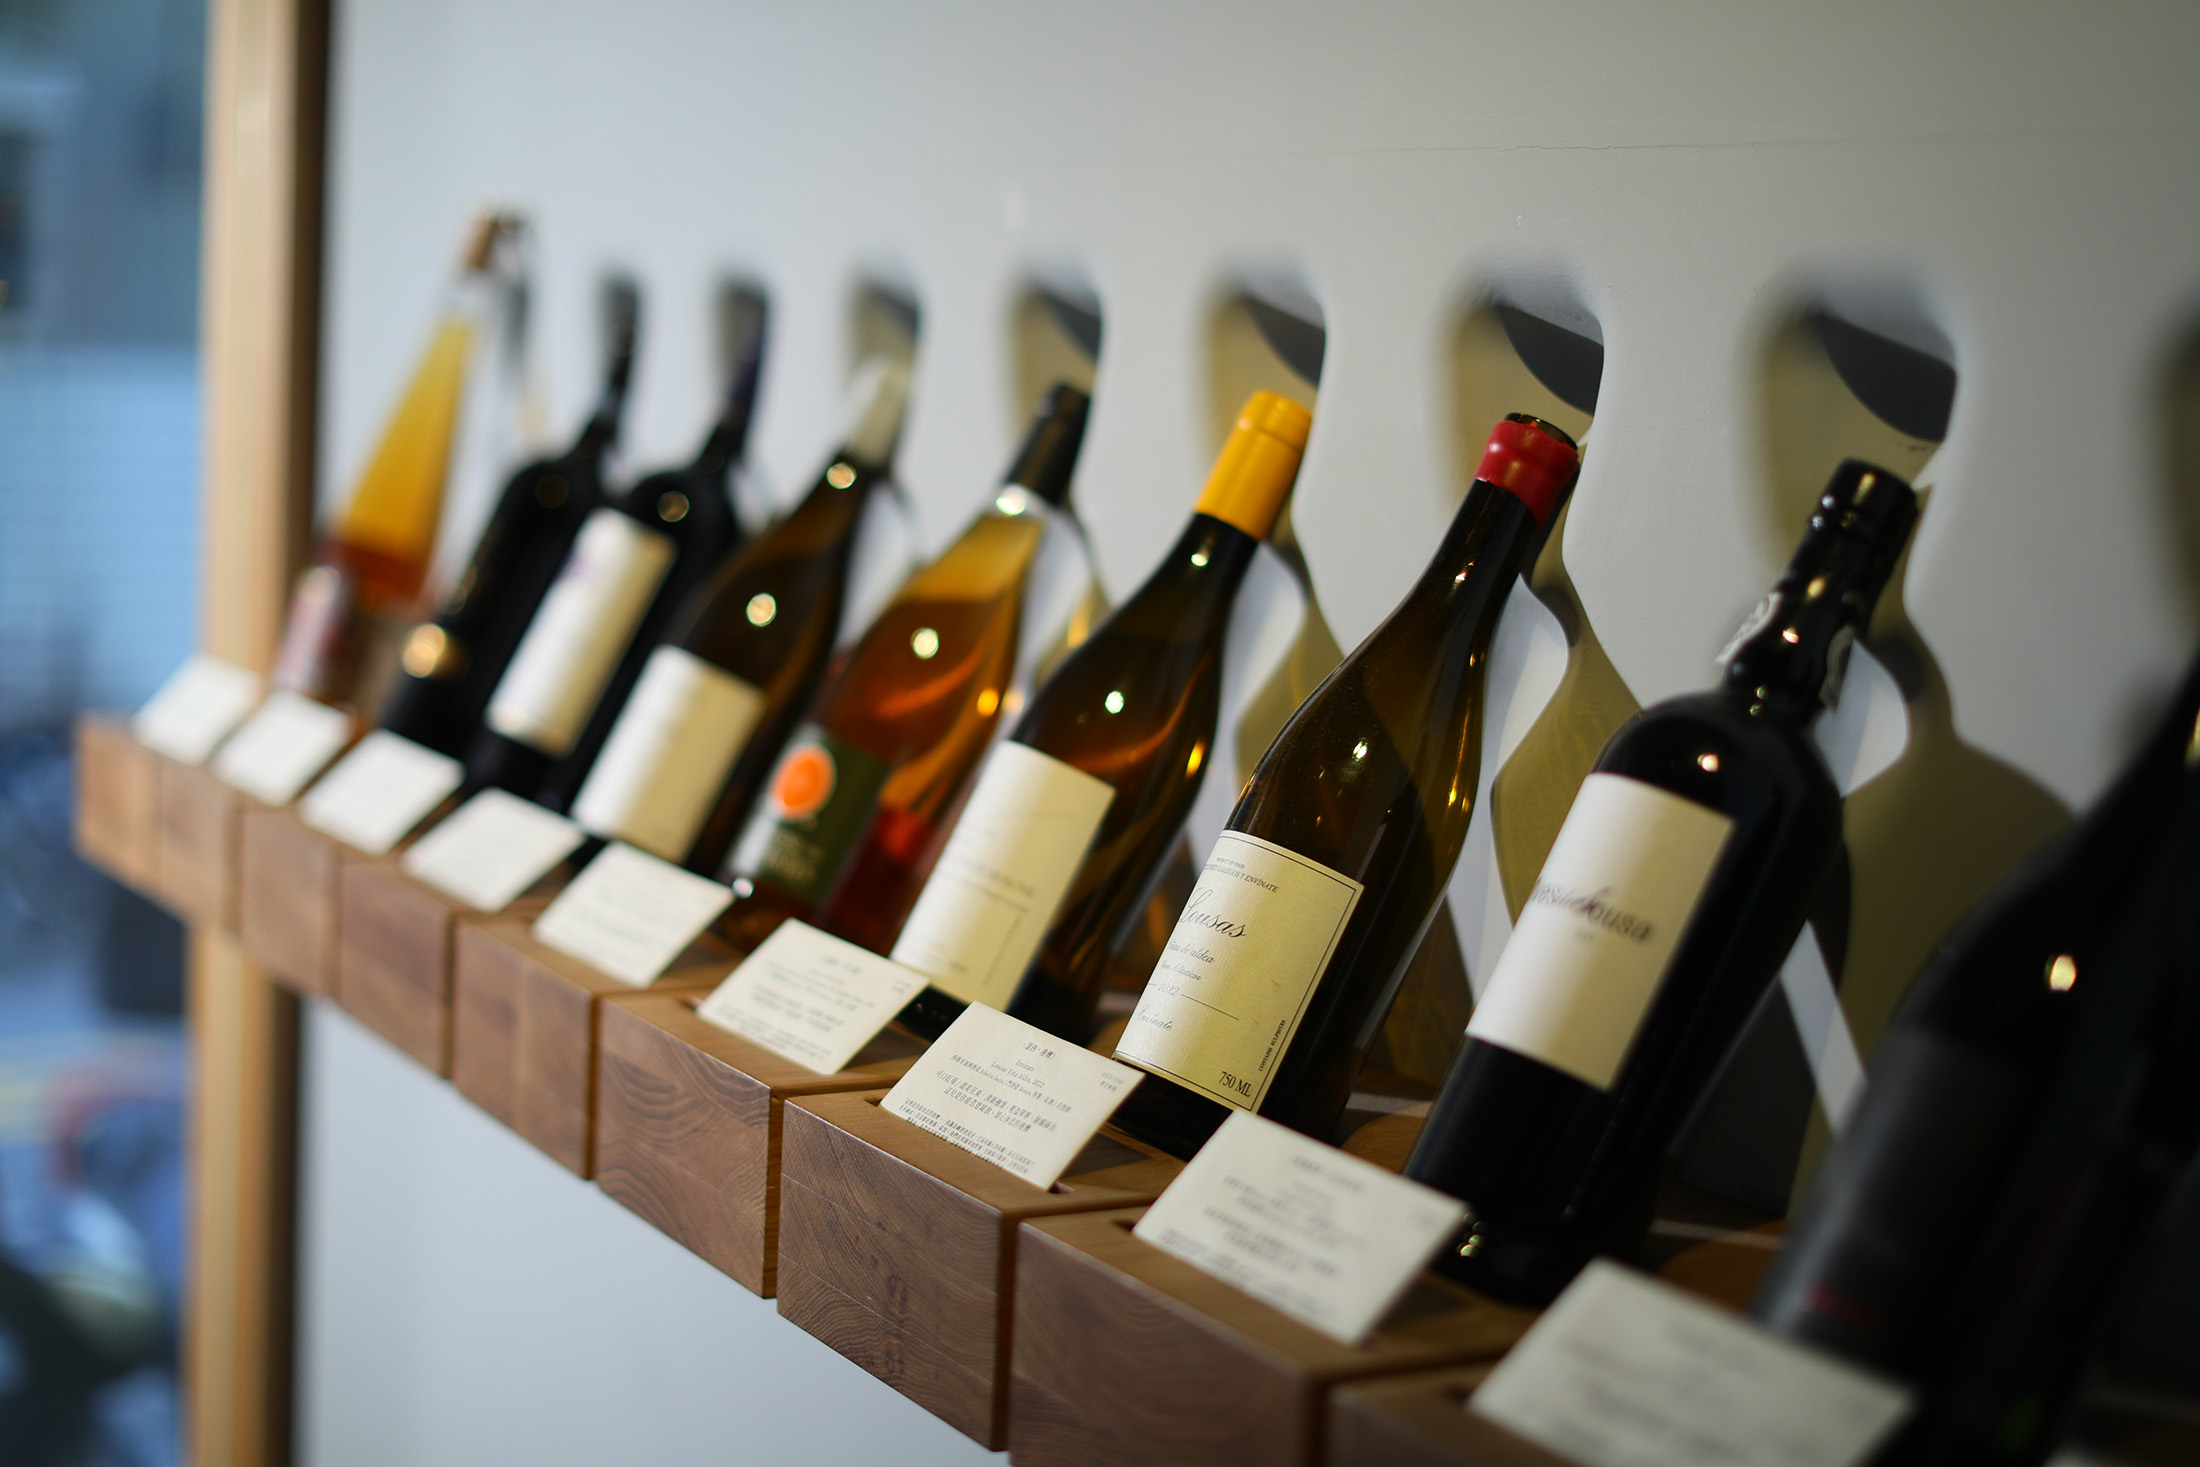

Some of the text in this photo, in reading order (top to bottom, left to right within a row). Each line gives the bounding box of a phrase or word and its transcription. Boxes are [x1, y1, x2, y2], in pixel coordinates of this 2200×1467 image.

[1244, 874, 1279, 893] ENVÍNATE
[1188, 944, 1215, 964] aldea
[1258, 1047, 1273, 1072] CONTAINS
[1218, 1071, 1253, 1098] 750 ML
